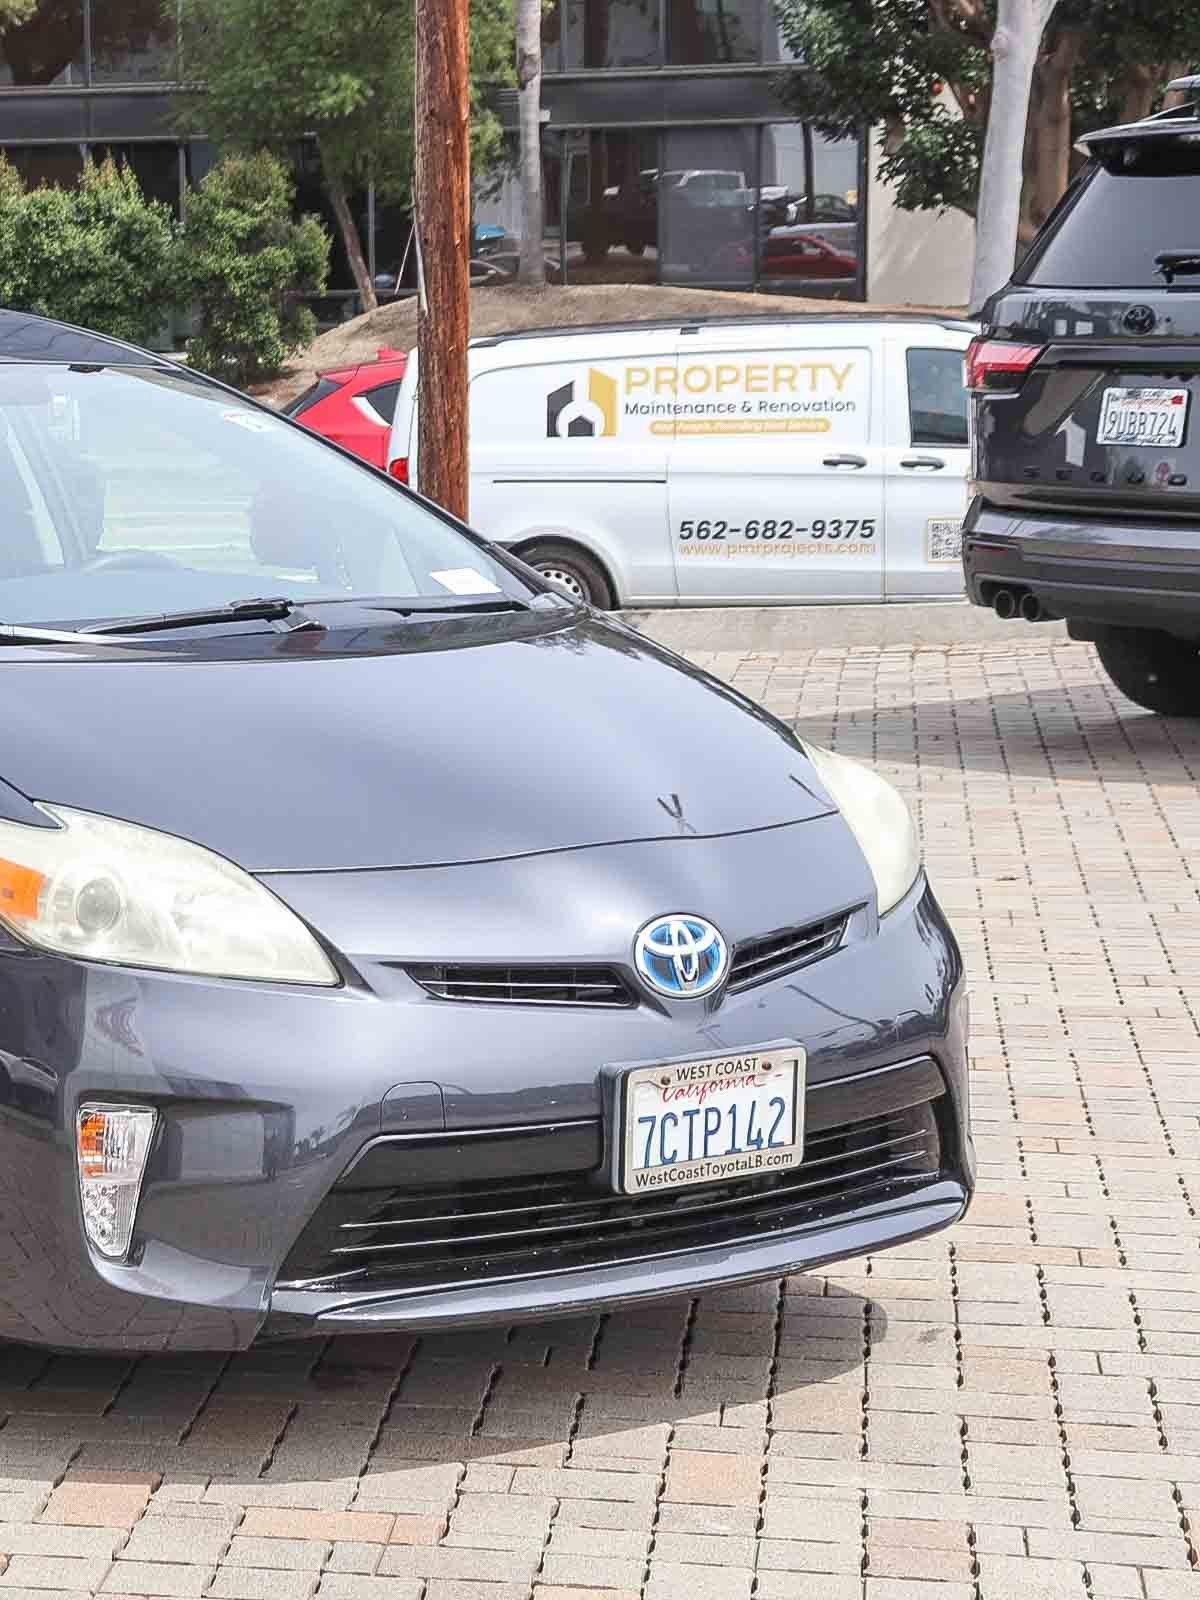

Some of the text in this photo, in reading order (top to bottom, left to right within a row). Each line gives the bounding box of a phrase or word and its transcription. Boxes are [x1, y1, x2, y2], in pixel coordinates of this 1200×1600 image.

[624, 362, 855, 395] PROPERTY
[625, 397, 856, 415] Maintenance & Renovation
[679, 519, 876, 540] 562-682-9375
[676, 1057, 759, 1081] WEST COAST
[638, 1096, 786, 1169] 7CTP142
[635, 1151, 793, 1188] WestCoastToyotaLB.com
